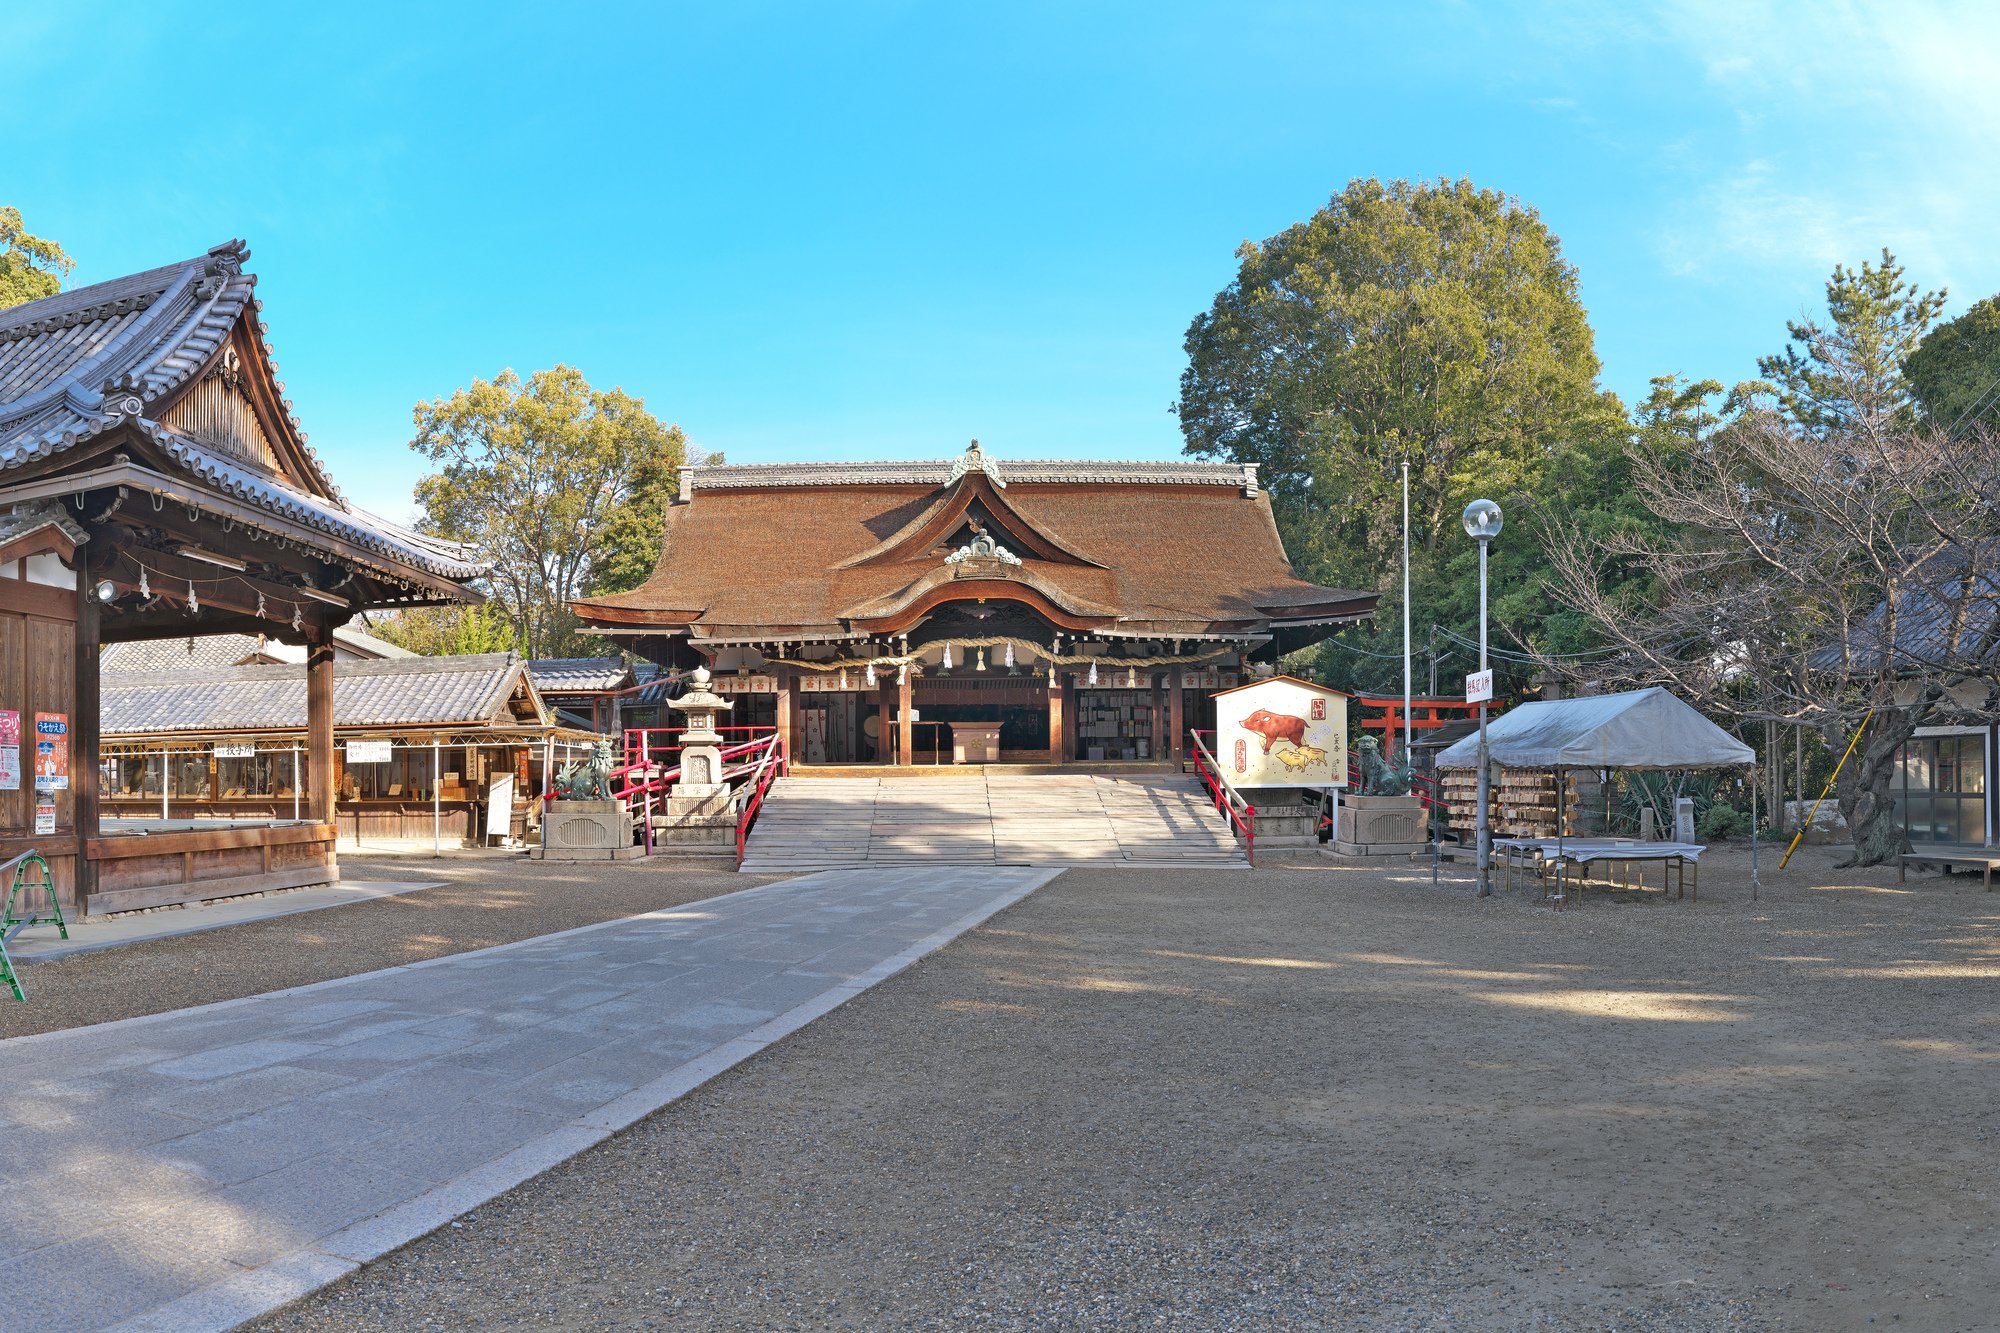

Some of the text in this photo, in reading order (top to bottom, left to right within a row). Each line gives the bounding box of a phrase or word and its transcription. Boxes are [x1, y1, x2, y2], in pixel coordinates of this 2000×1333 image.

[38, 721, 66, 734] うそかえ祭
[225, 742, 254, 756] 授与所
